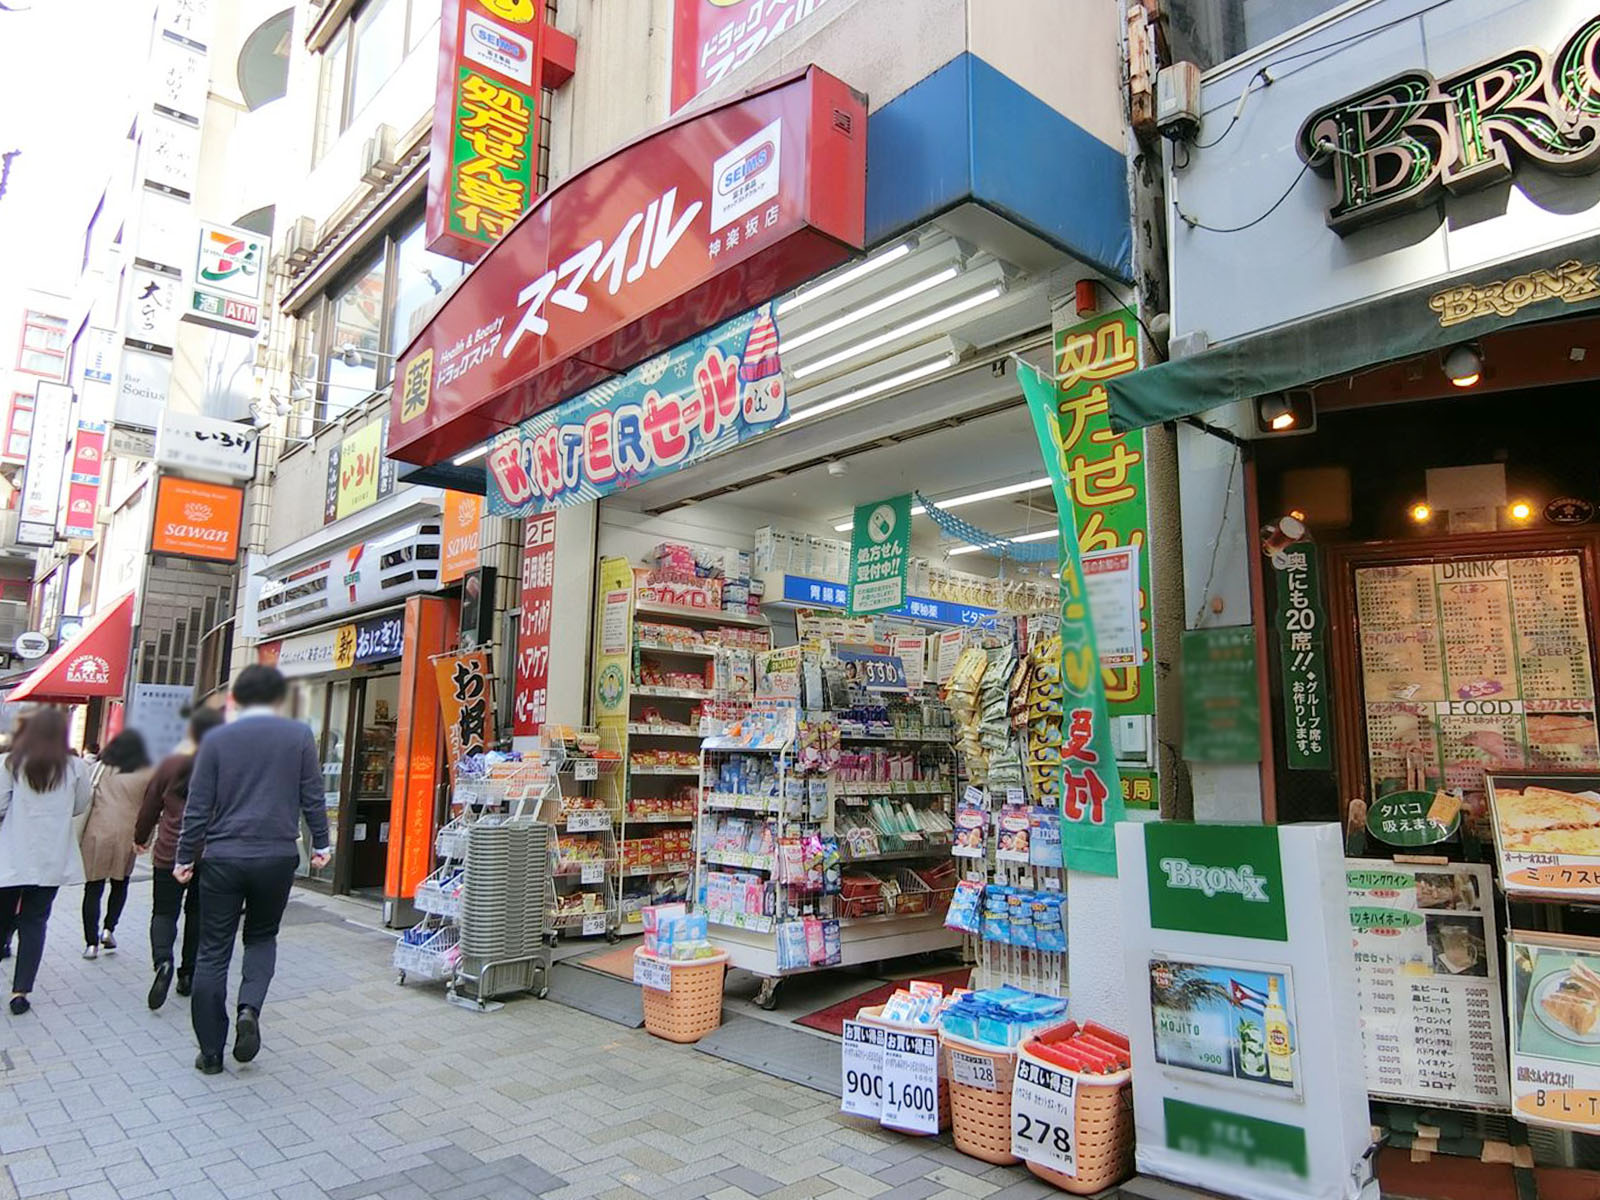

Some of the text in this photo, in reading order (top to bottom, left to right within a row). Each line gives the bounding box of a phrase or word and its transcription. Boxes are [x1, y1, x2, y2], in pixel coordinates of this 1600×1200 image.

[478, 29, 520, 57] SEIMS
[725, 151, 767, 187] SEIMS
[708, 205, 779, 260] 神楽坂店
[503, 187, 703, 359] スマイル
[1429, 261, 1600, 327] BRONX
[226, 301, 256, 324] ATM
[440, 340, 465, 366] Health
[474, 316, 505, 344] Beauty
[437, 333, 502, 390] ドラッグストア
[122, 383, 167, 401] Socius
[404, 358, 430, 418] 薬
[195, 431, 251, 453] いろり
[342, 445, 377, 491] いろり
[164, 523, 230, 543] sawan
[527, 519, 553, 546] 2F
[857, 539, 903, 564] 処方せん
[1443, 561, 1499, 580] DRINK
[657, 587, 706, 608] カイロ
[809, 584, 847, 604] 胃腸薬
[337, 630, 353, 663] 新
[356, 619, 402, 659] おにぎり
[518, 646, 549, 679] ヘアケア
[1449, 700, 1514, 715] FOOD
[1380, 802, 1422, 817] タバコ
[1382, 819, 1440, 834] 吸えます
[1159, 858, 1270, 902] BRONX
[845, 1023, 885, 1047] お買い得品
[1160, 1020, 1200, 1036] MOJITO
[886, 1032, 935, 1057] お買い得品
[847, 1070, 884, 1100] 900
[973, 1066, 994, 1082] 128
[1018, 1059, 1073, 1097] お買い得品
[1420, 1080, 1457, 1091] コロナ
[888, 1081, 935, 1112] 1,600
[1017, 1113, 1071, 1153] 278
